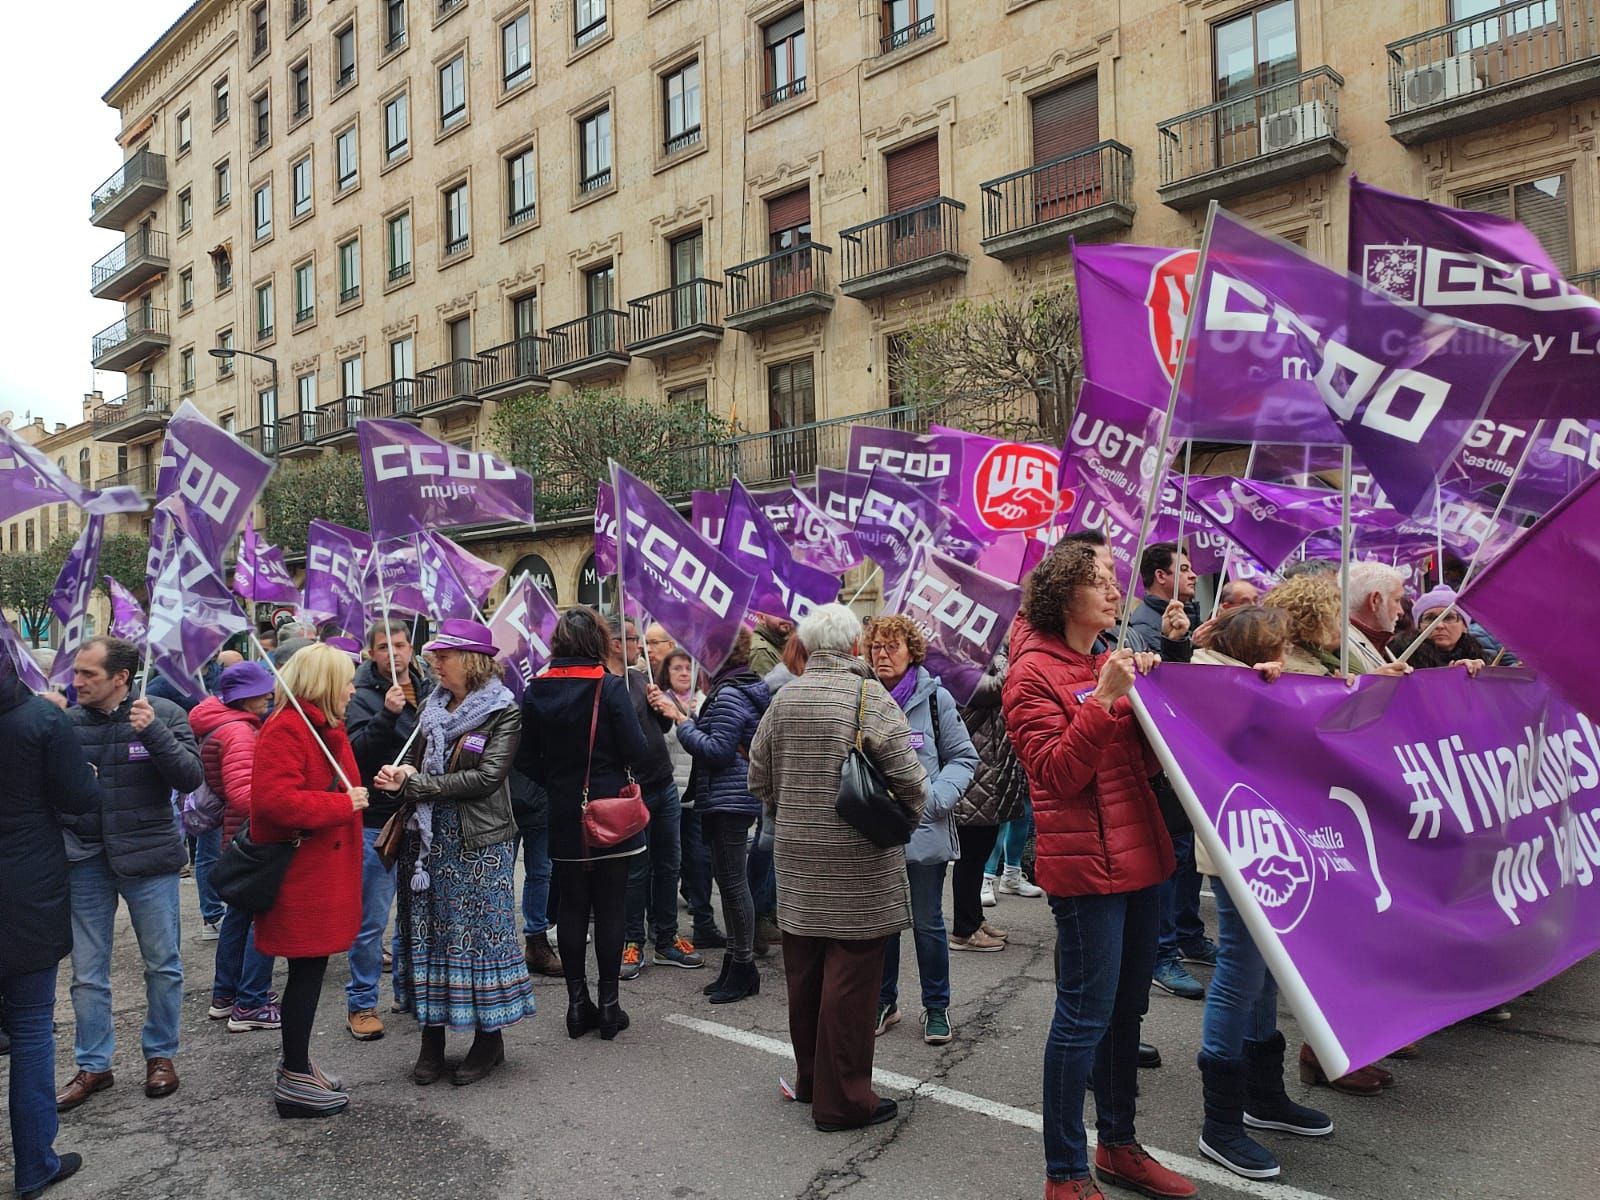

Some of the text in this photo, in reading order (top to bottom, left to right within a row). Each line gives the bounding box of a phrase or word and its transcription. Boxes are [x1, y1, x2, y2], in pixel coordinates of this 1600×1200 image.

[1532, 333, 1556, 362] y
[1071, 412, 1144, 467] UGT
[1461, 419, 1527, 456] GT
[372, 444, 516, 482] CCOO
[858, 446, 951, 478] CCOO
[988, 455, 1059, 497] UGT
[1088, 457, 1128, 488] Castilla
[421, 482, 477, 500] mujer
[861, 488, 935, 557] CCO
[643, 561, 688, 604] mujer
[1228, 808, 1298, 868] UGT
[1492, 834, 1550, 926] por
